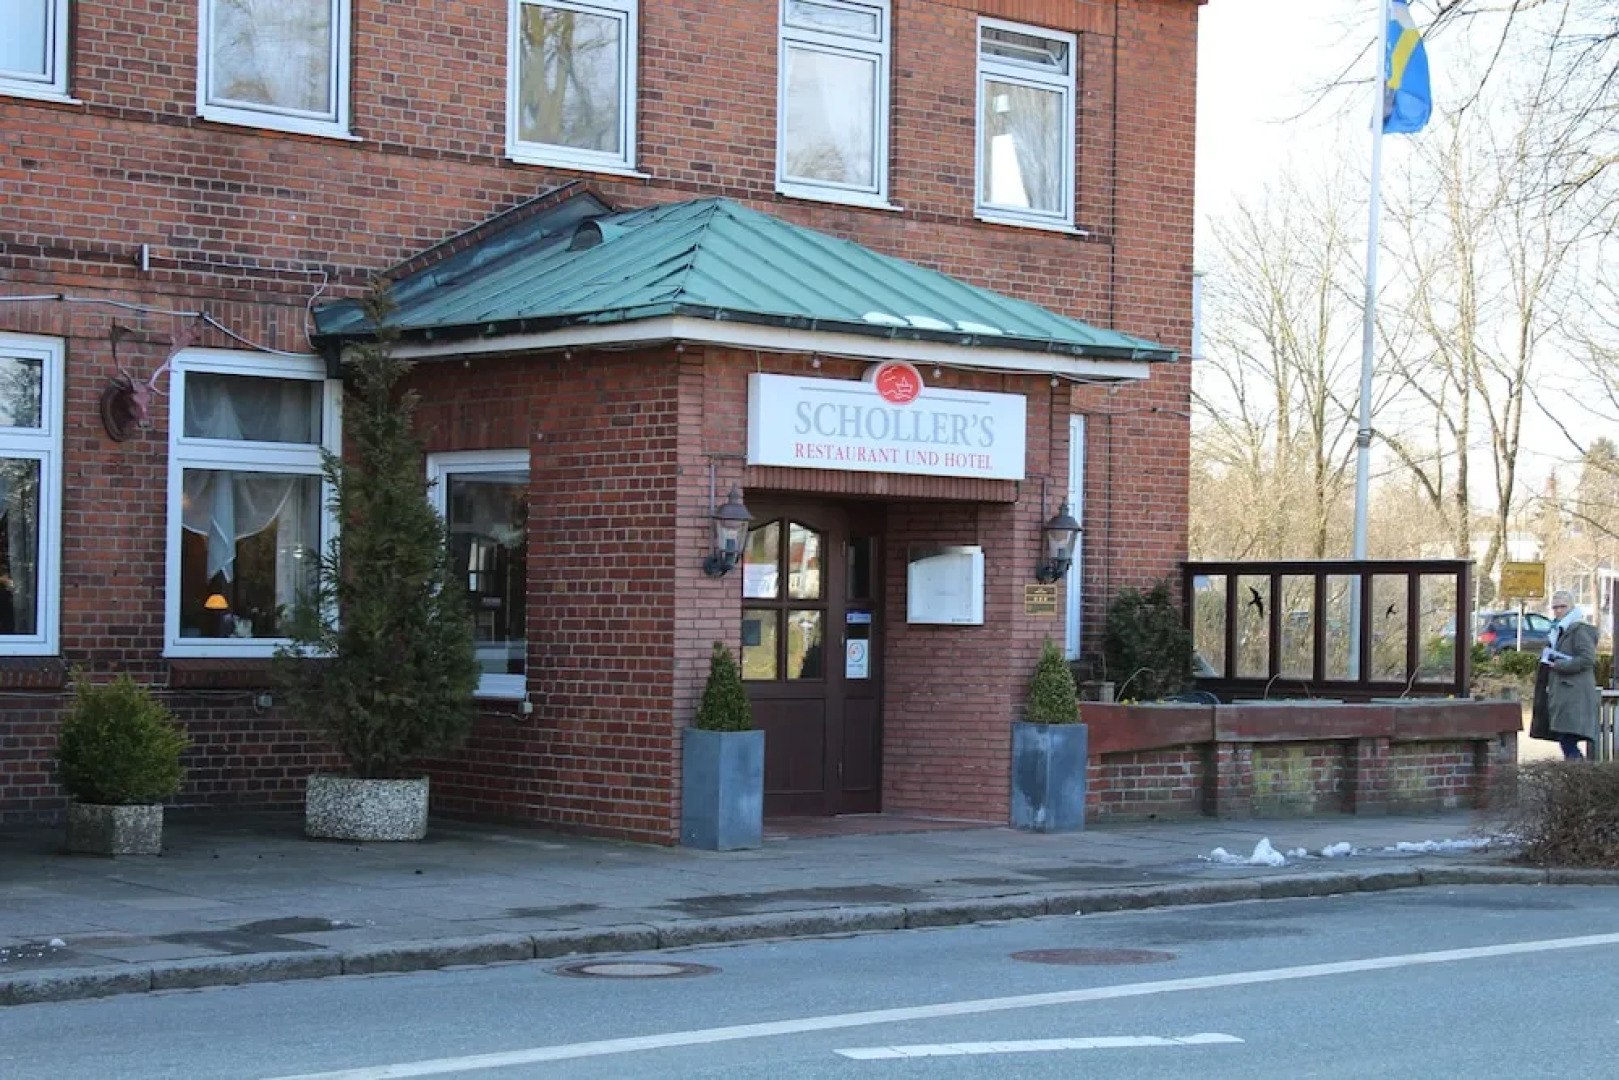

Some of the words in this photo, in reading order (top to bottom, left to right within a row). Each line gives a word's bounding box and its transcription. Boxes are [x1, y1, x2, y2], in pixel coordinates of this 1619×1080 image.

[794, 401, 994, 447] SCHOLLER'S
[795, 443, 899, 464] RESTAURANT
[906, 450, 939, 467] UND
[945, 453, 993, 470] HOTEL
